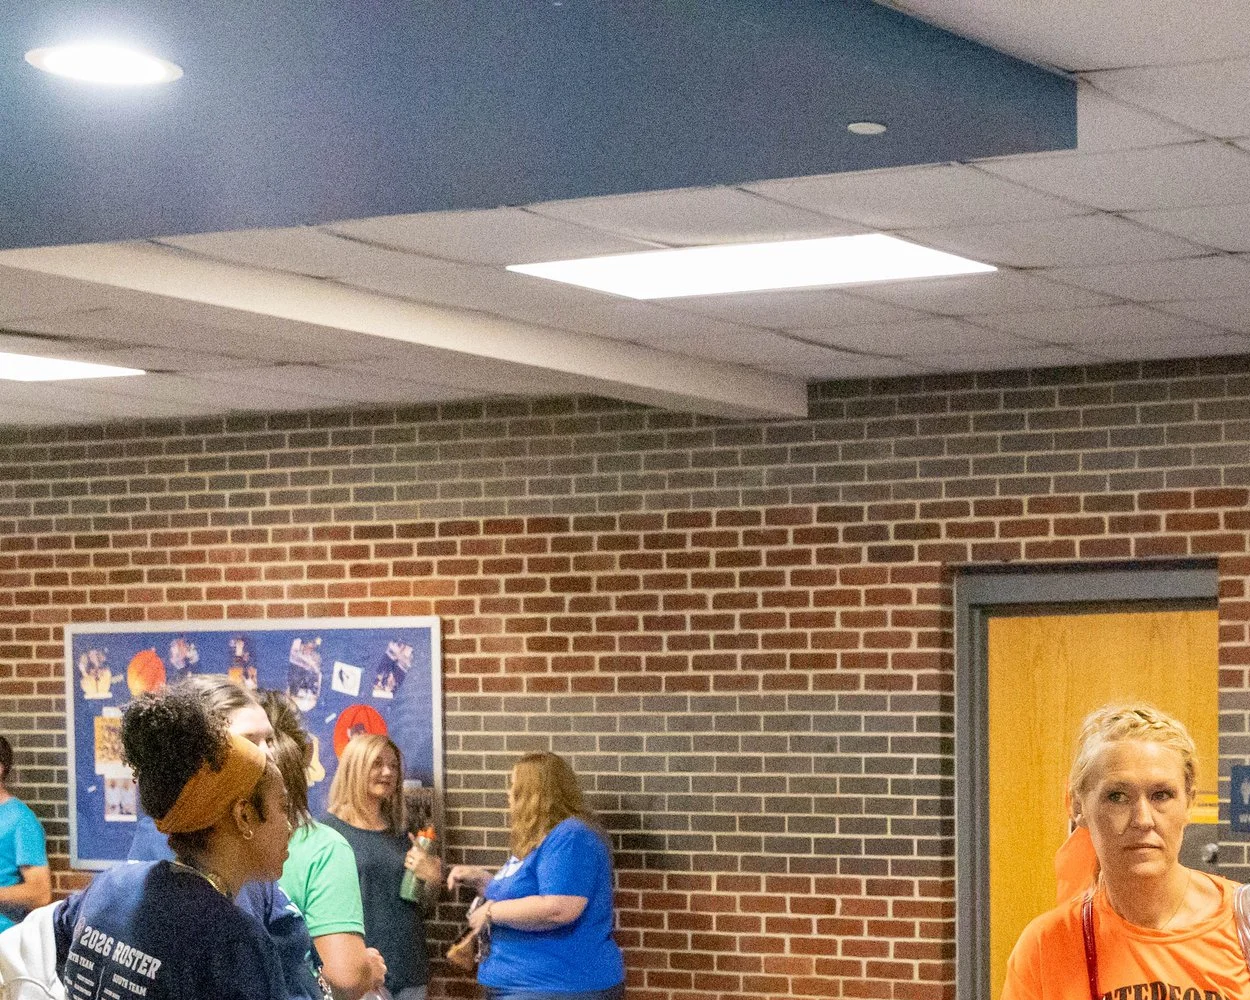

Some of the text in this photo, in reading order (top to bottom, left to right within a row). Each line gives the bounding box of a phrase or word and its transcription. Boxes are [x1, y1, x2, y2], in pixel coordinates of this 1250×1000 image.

[80, 926, 114, 957] 2026
[111, 941, 162, 980] ROSTER
[79, 955, 95, 971] TEAM
[128, 981, 148, 997] TEAM
